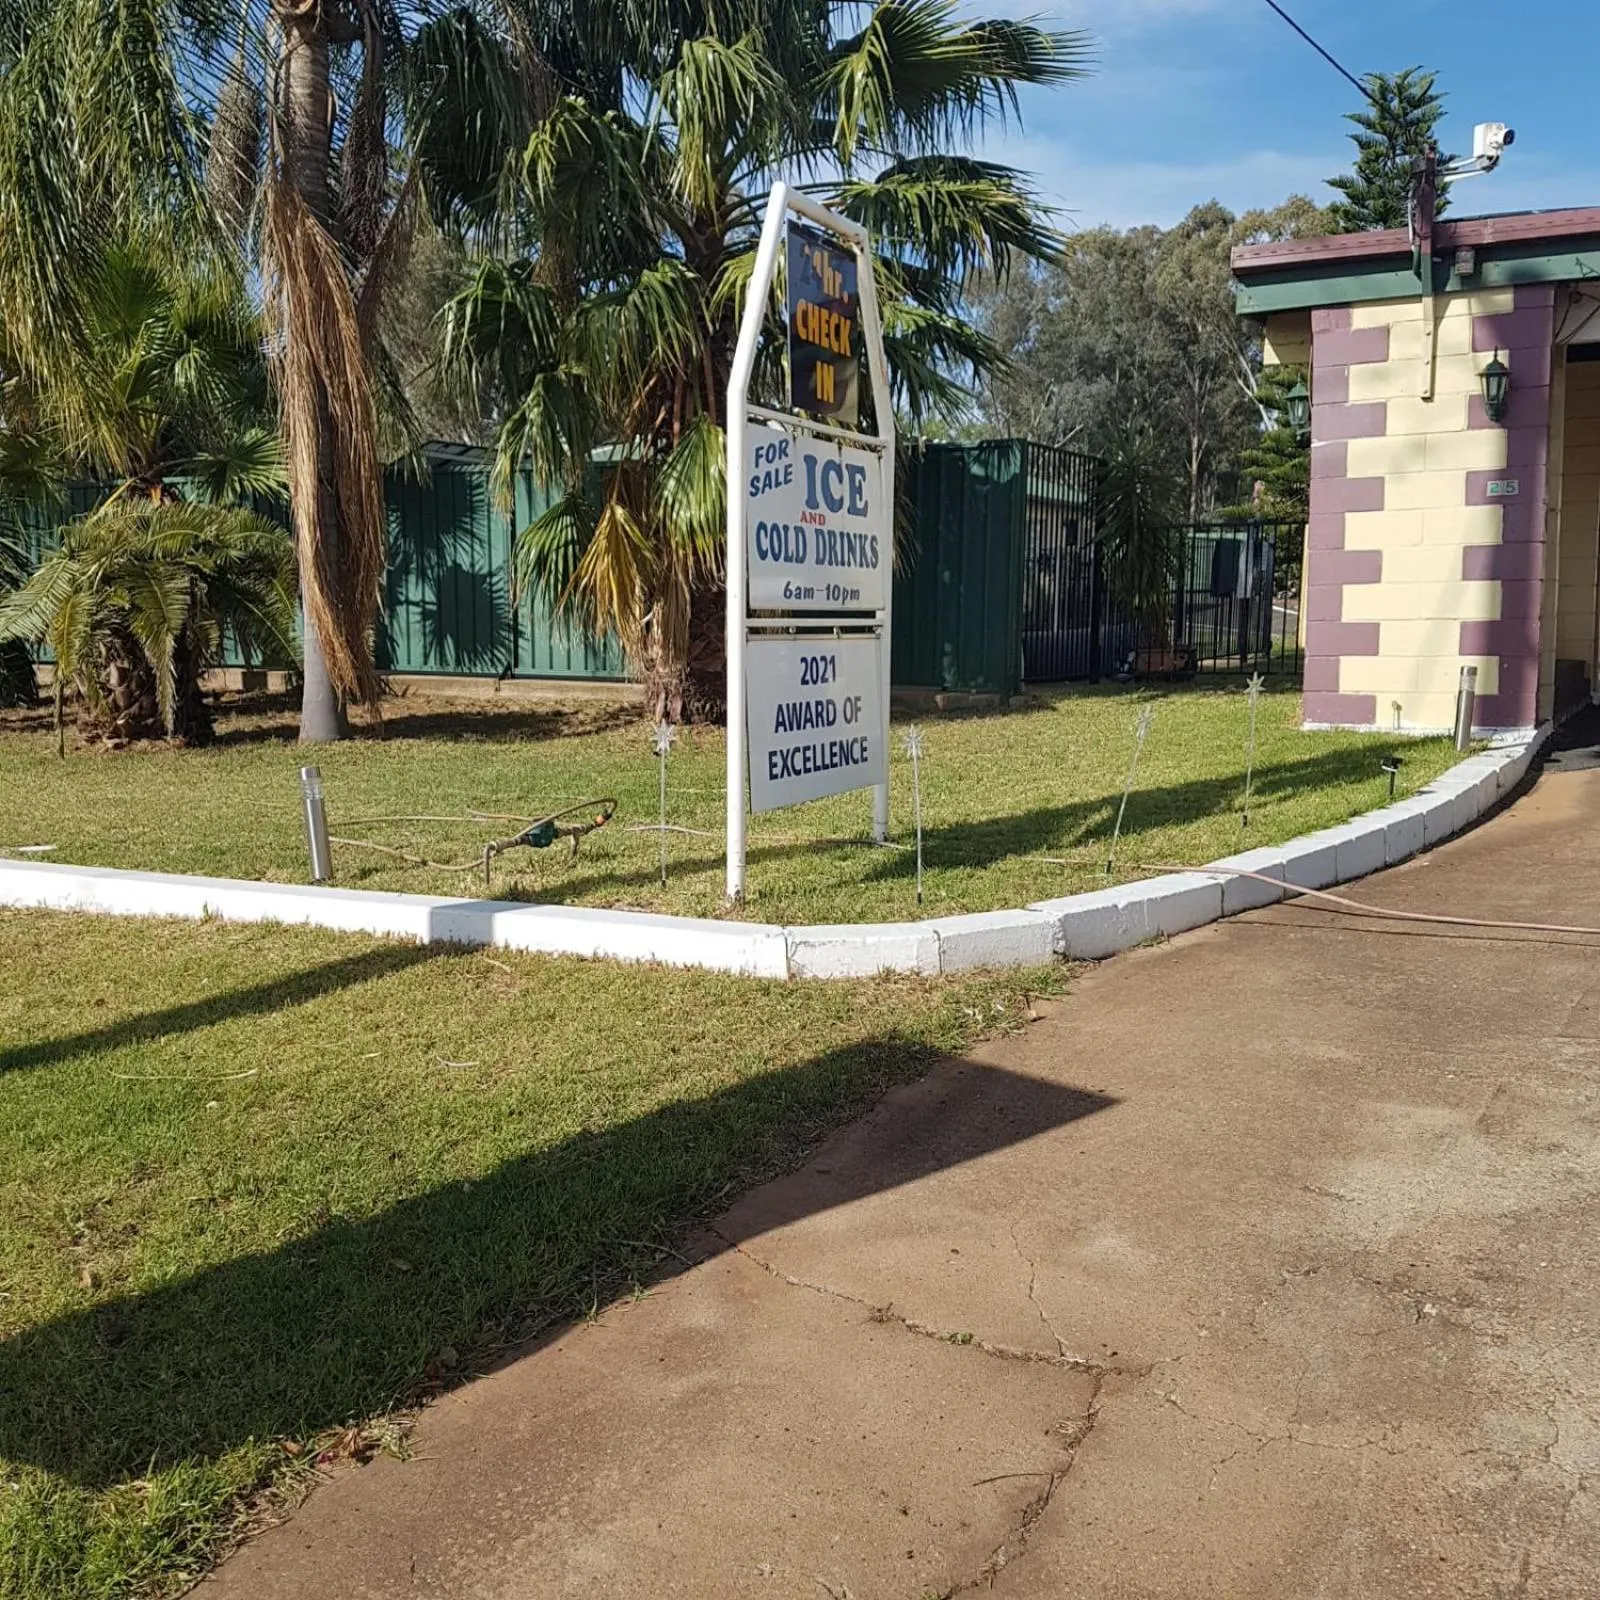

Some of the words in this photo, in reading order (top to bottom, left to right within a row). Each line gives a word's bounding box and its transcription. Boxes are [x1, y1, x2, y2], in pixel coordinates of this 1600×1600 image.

[796, 298, 851, 358] CHECK
[816, 360, 834, 403] IN
[755, 438, 789, 468] FOR
[749, 464, 793, 497] SALE
[803, 454, 868, 518] ICE
[800, 510, 826, 526] AND
[755, 521, 807, 564] COLD
[815, 528, 879, 569] DRINKS
[800, 655, 836, 686] 2021
[774, 699, 837, 734] AWARD
[843, 696, 862, 724] OF
[768, 736, 868, 781] EXCELLENCE
